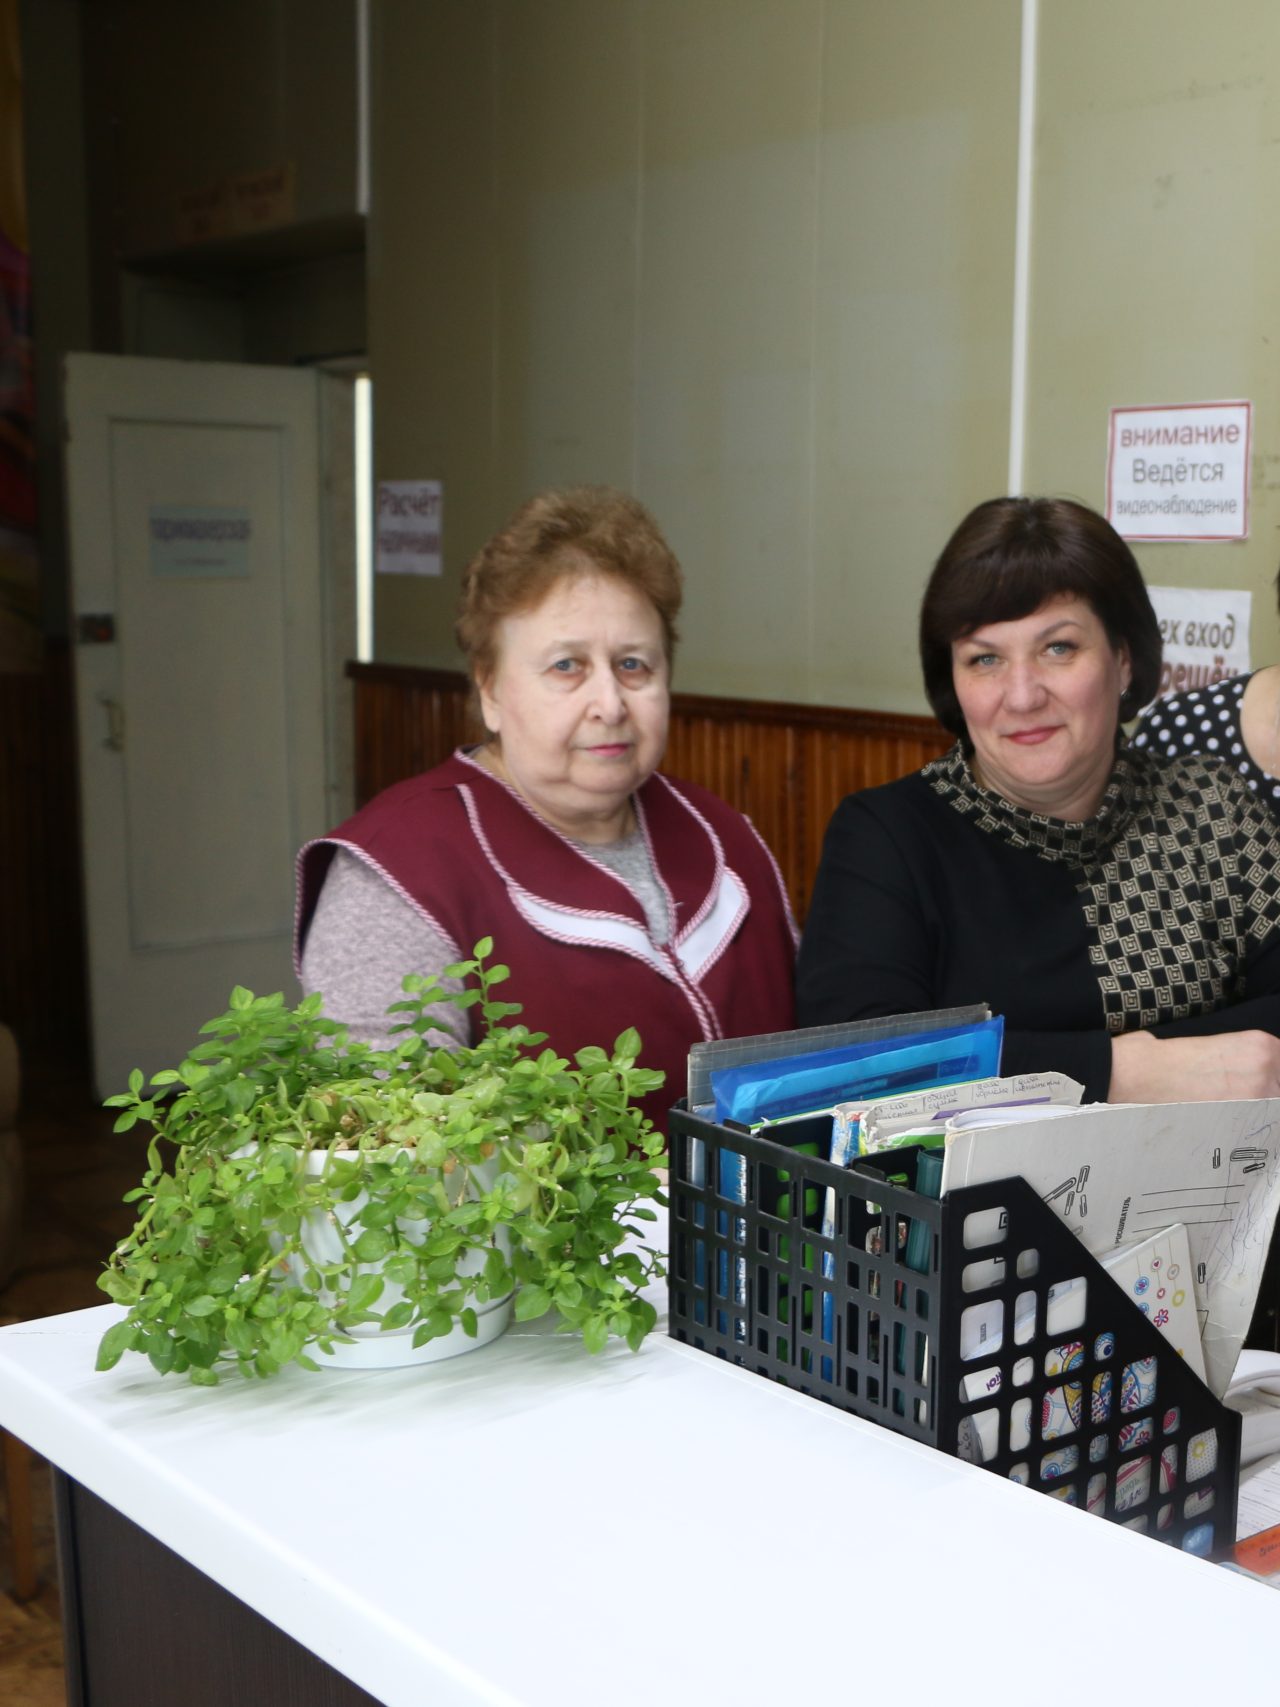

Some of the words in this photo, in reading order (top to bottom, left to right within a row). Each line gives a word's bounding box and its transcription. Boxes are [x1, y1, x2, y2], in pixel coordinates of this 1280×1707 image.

[1120, 423, 1240, 448] внимание
[1132, 457, 1225, 485] Ведётся
[1116, 494, 1238, 516] видеонаблюдение
[1157, 619, 1182, 646] ех
[1184, 612, 1235, 651] вход
[1114, 1196, 1132, 1249] РОСШИВАТЕЛЬ
